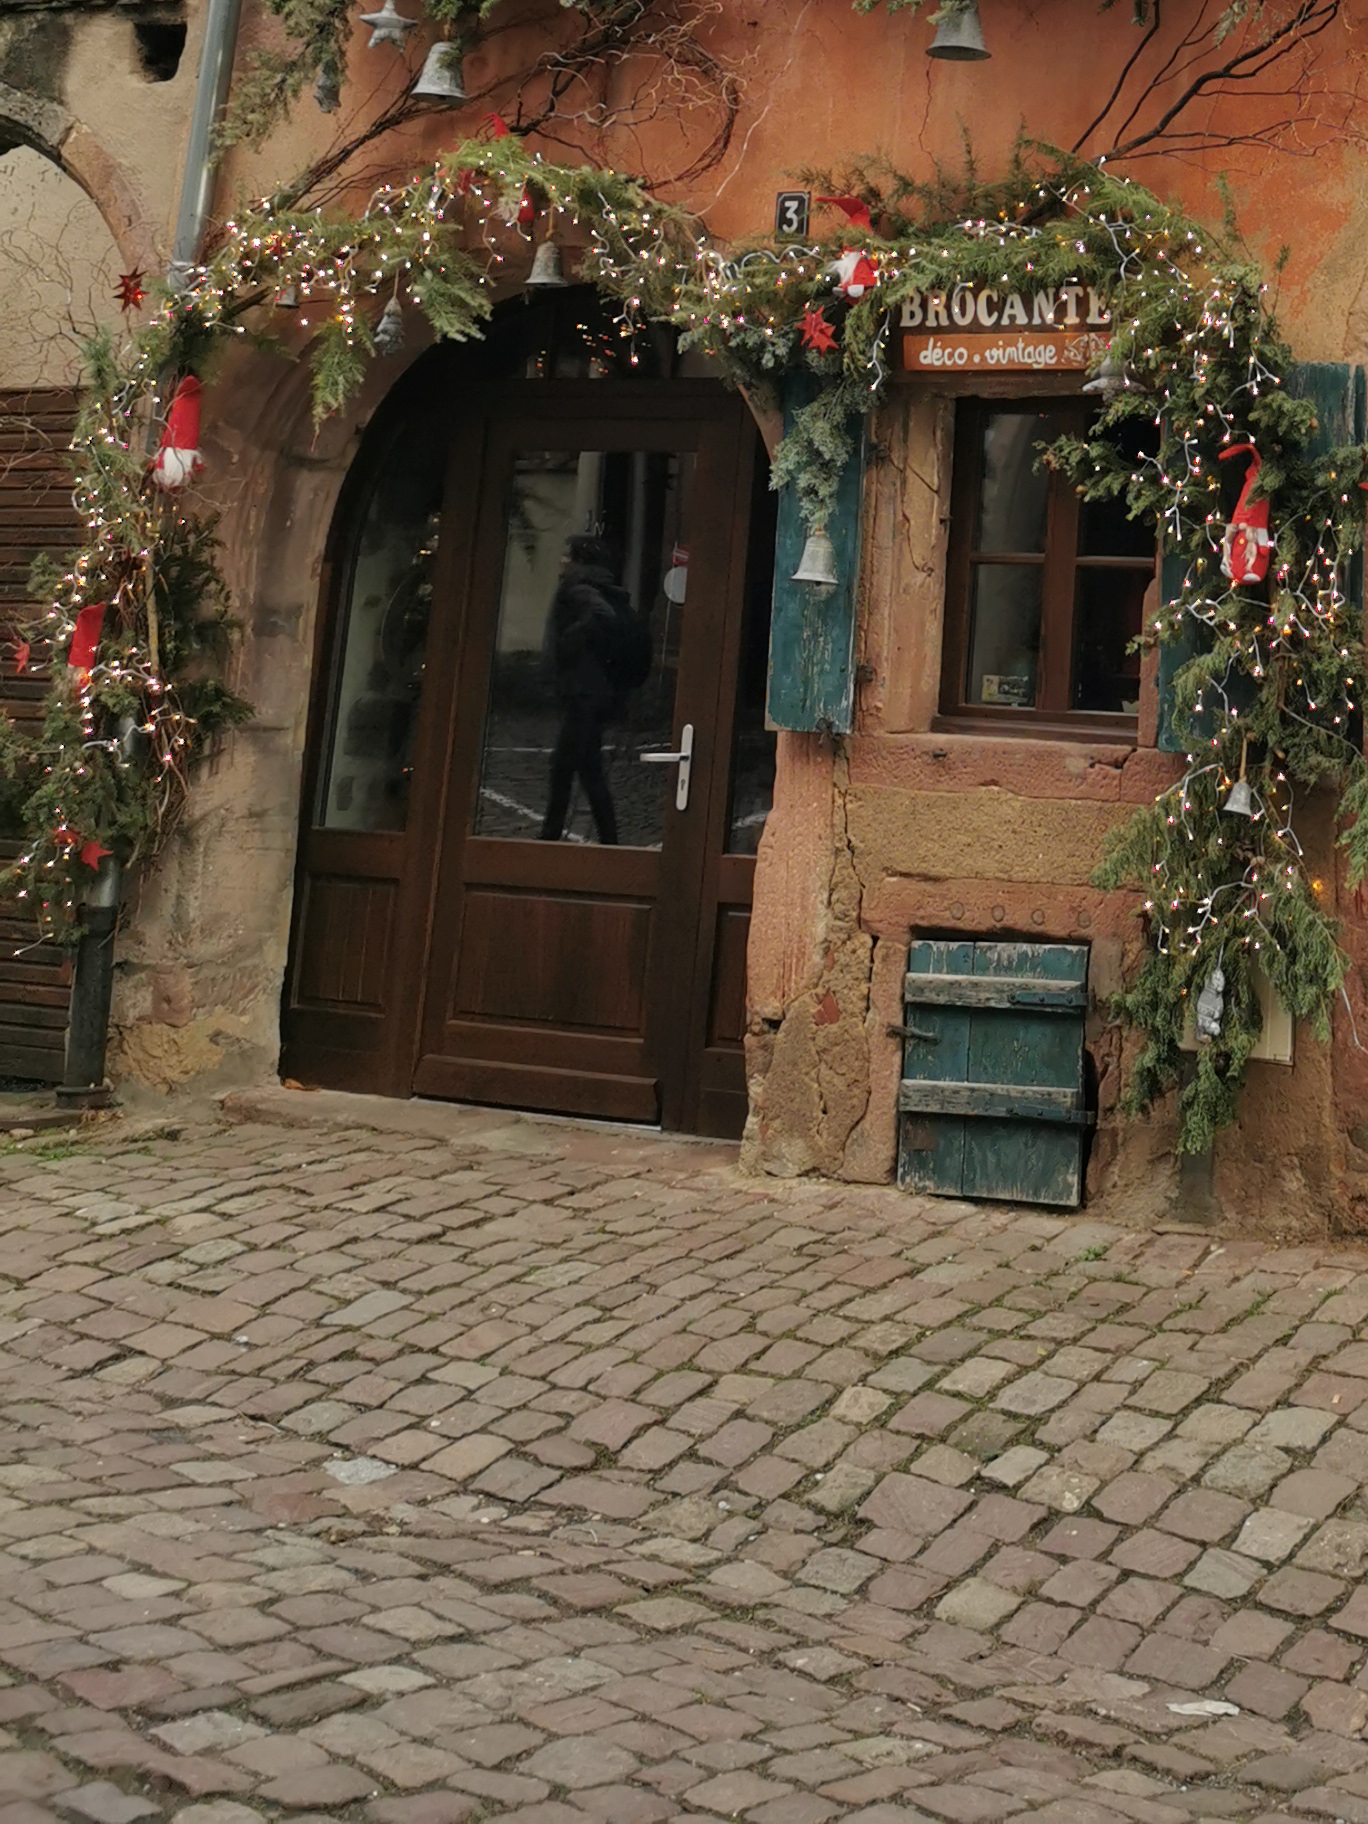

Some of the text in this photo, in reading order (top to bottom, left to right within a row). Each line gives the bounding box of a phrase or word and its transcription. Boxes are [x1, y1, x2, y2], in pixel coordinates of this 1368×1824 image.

[780, 200, 799, 234] 3
[899, 285, 1112, 327] BROCANTE
[919, 337, 1059, 369] déco vintage
